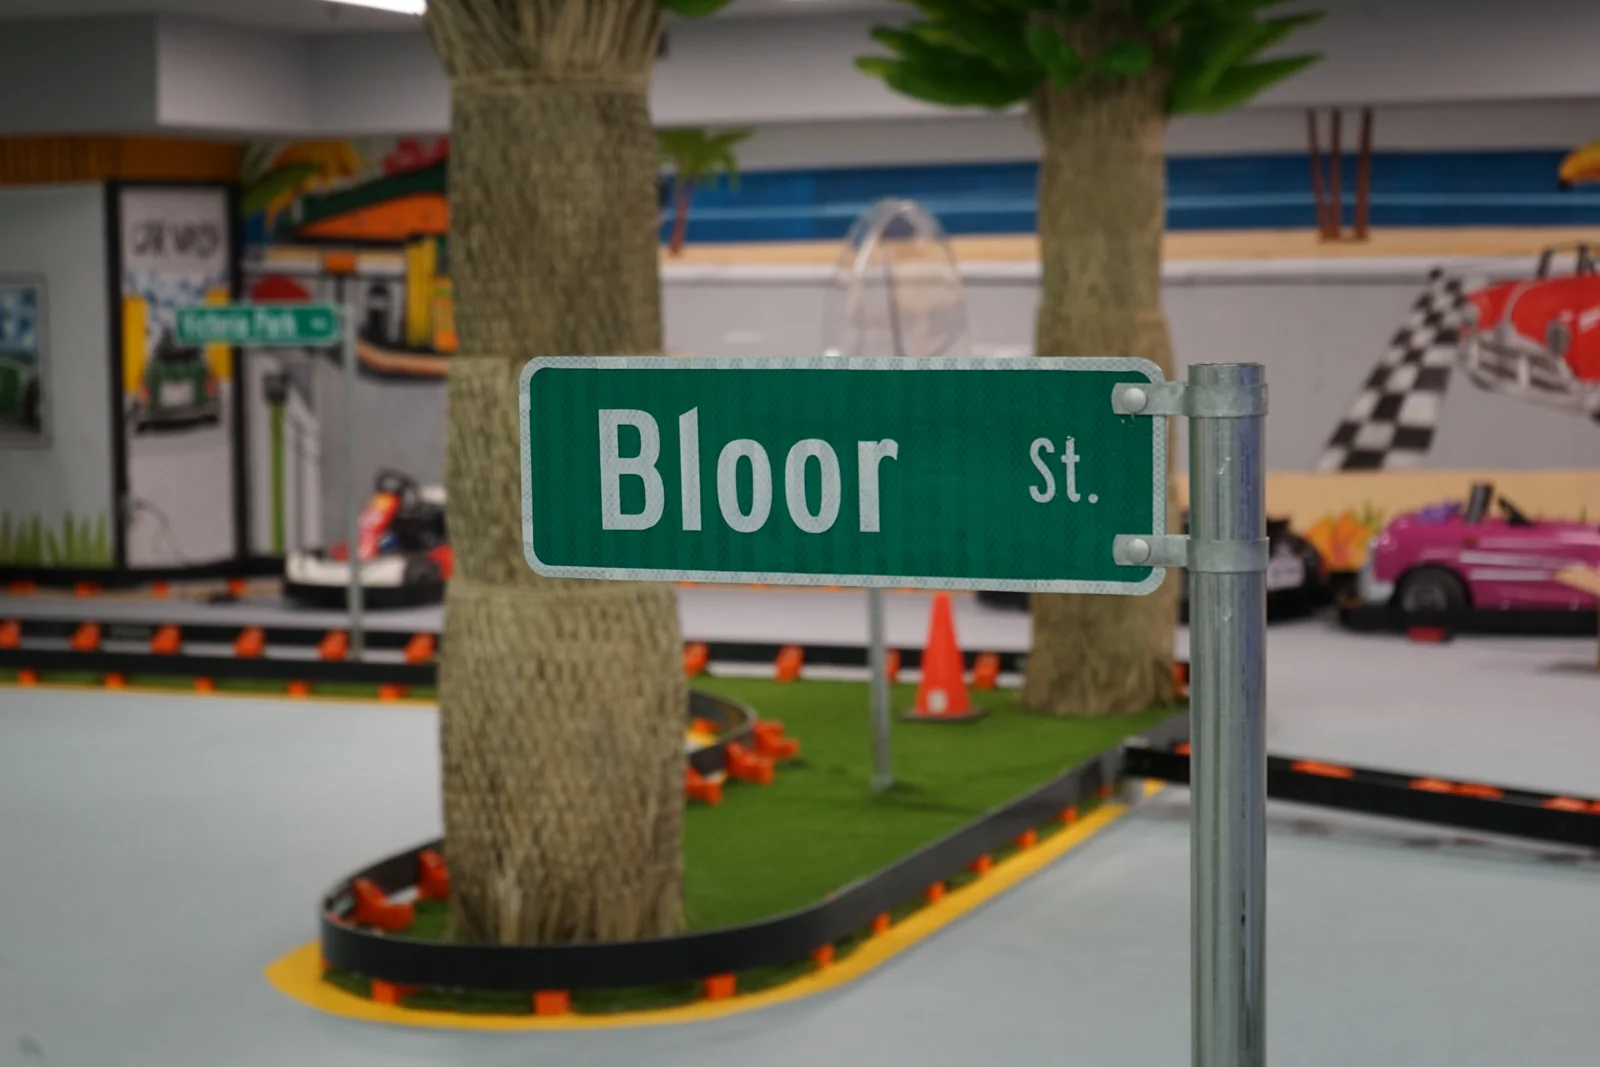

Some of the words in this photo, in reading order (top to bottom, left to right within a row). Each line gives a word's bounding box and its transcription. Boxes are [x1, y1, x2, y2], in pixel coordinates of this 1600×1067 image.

[254, 308, 297, 338] Park
[598, 406, 898, 534] Bloor
[1028, 436, 1099, 504] St.
